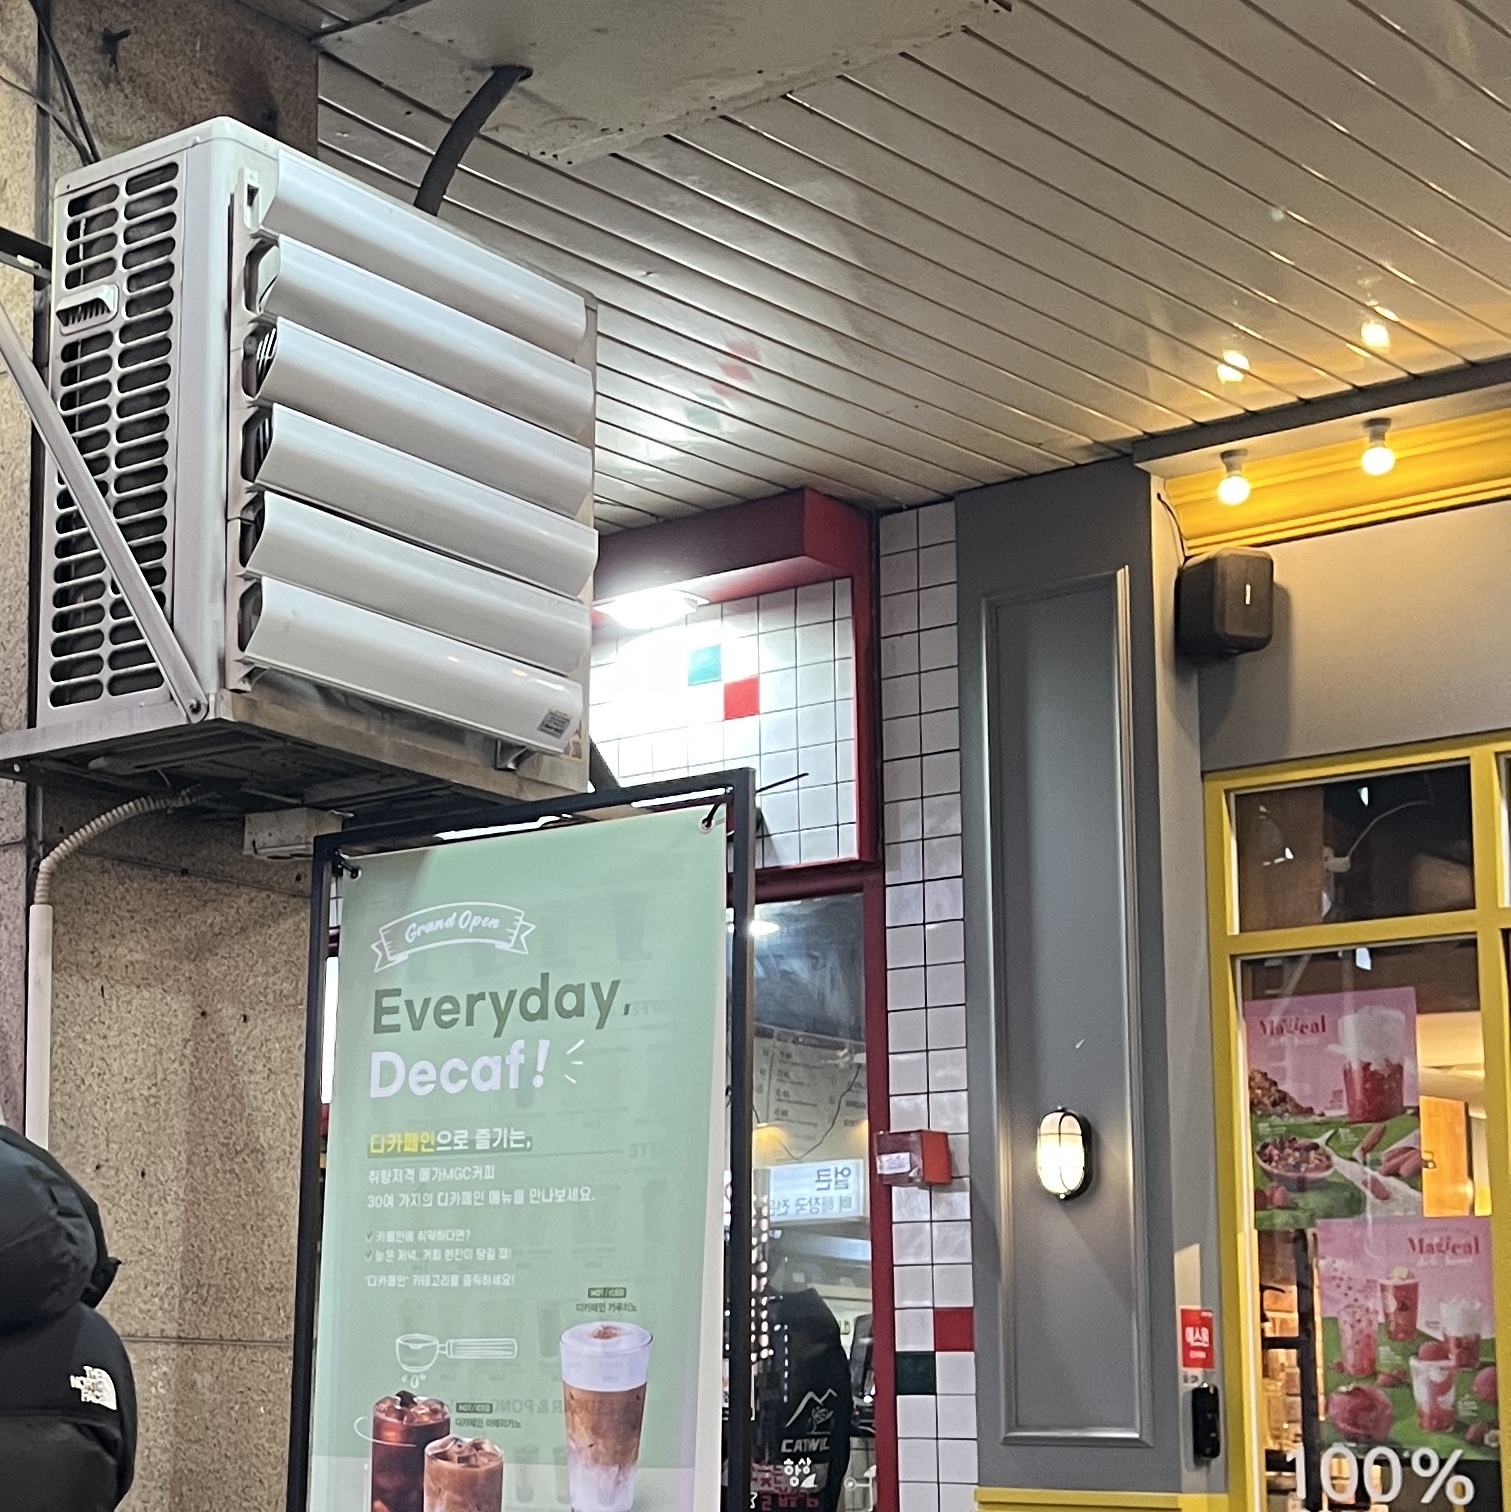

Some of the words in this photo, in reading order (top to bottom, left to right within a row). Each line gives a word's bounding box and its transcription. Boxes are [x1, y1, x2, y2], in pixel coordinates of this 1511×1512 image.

[404, 911, 458, 944] Grand
[457, 908, 501, 937] Open
[370, 1039, 551, 1099] Decaf!
[370, 1129, 469, 1154] 디카페인으로
[367, 1193, 394, 1208] 30여
[399, 1192, 434, 1207] 가지의
[437, 1190, 486, 1206] 디카페인
[1286, 1447, 1474, 1504] 100%
